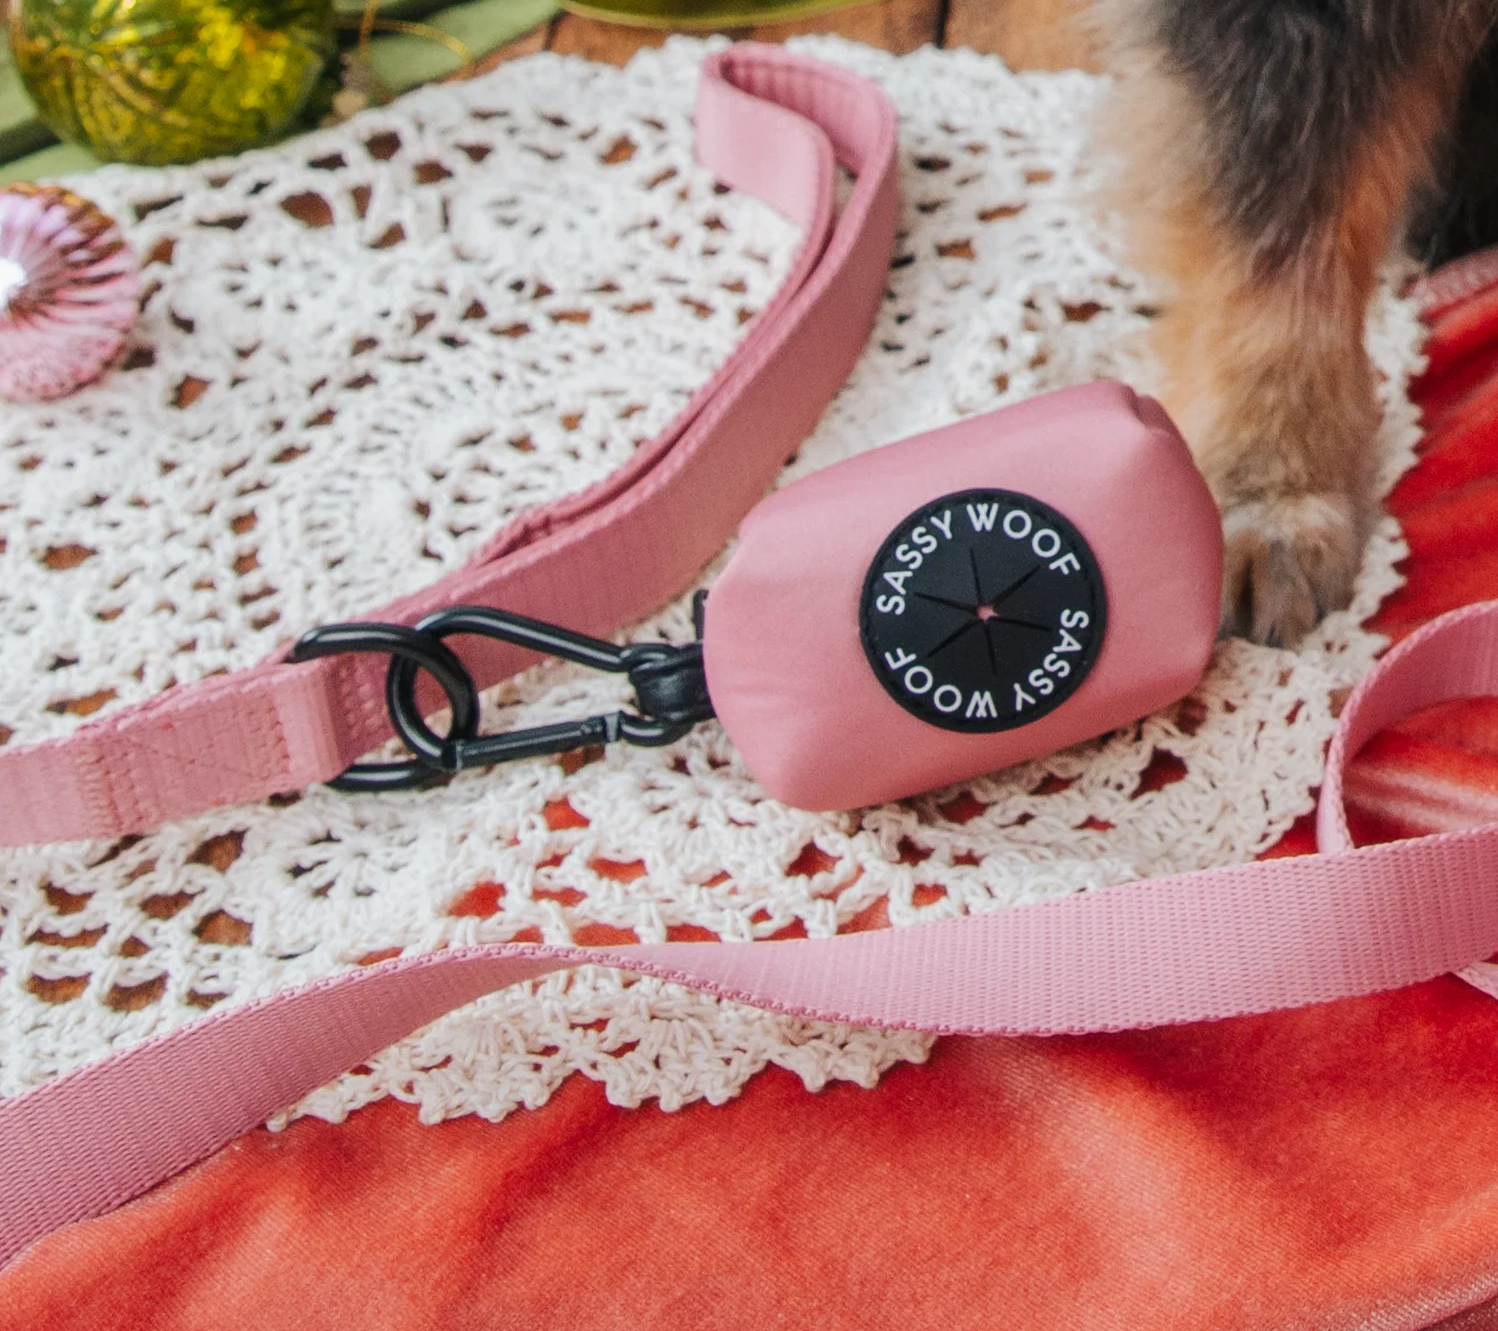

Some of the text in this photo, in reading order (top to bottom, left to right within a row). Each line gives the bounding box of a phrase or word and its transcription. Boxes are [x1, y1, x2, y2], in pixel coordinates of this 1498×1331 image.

[876, 502, 1080, 615] SASSY WOOF
[885, 608, 1090, 718] SASSY WOOF
